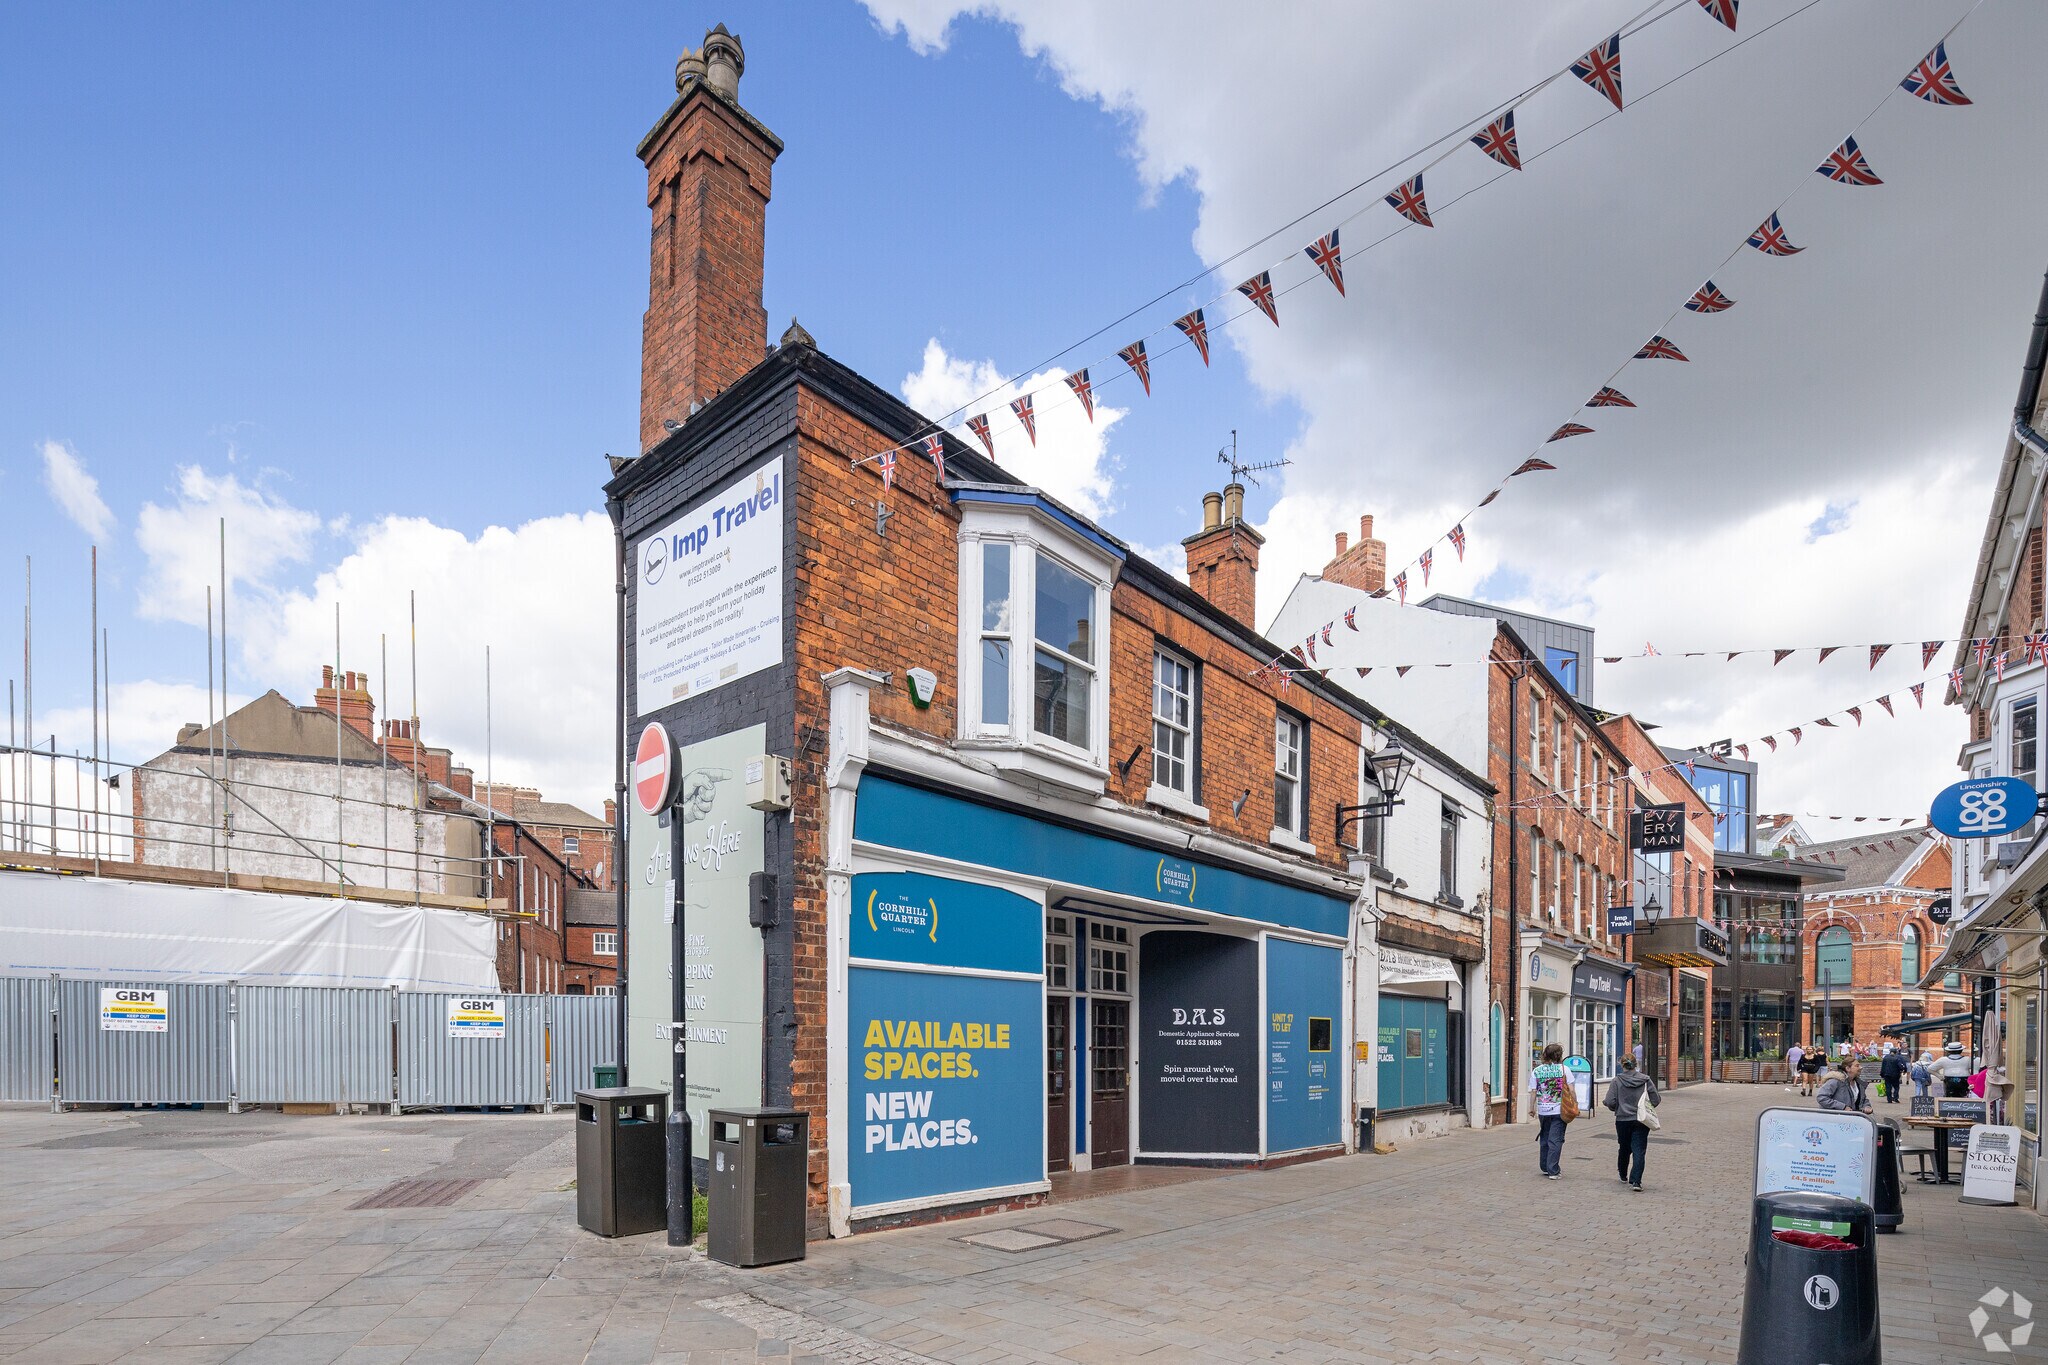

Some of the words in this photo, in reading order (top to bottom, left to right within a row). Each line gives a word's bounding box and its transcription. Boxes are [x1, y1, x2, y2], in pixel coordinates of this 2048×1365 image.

[672, 525, 708, 561] Imp
[712, 474, 778, 536] Travel
[679, 546, 730, 578] www.imptravel.co.uk
[687, 573, 702, 586] 01522
[640, 629, 644, 637] A
[645, 623, 656, 634] local
[658, 609, 688, 628] independent
[689, 600, 703, 613] travel
[705, 593, 719, 606] agent
[721, 586, 732, 597] with
[734, 582, 742, 591] the
[744, 565, 777, 586] experience
[649, 634, 658, 644] and
[659, 623, 685, 639] knowledge
[693, 614, 704, 624] help
[706, 609, 715, 620] you
[717, 602, 727, 613] turn
[729, 595, 742, 608] your
[743, 584, 765, 599] holiday
[667, 638, 676, 648] and
[677, 631, 691, 644] travel
[693, 623, 711, 636] dreams
[713, 618, 723, 627] into
[724, 606, 743, 622] reality!
[657, 661, 673, 672] including
[684, 652, 692, 661] Cost
[693, 646, 708, 656] Airlines
[711, 640, 722, 648] Tailor
[760, 615, 779, 627] Cruising
[663, 667, 680, 679] Protected
[682, 660, 699, 671] Packages
[703, 655, 709, 663] UK
[710, 648, 727, 660] Holidays
[732, 640, 746, 650] Coach
[748, 634, 760, 643] Tours
[1960, 781, 2007, 791] Lincolnshire
[1644, 811, 1664, 821] EV
[1644, 822, 1676, 834] ERY
[701, 820, 741, 872] HERE
[1644, 835, 1680, 847] MAN
[1163, 869, 1190, 881] CORNHILL
[1163, 877, 1189, 889] QUARTER
[878, 902, 928, 917] CORNHILL
[881, 912, 926, 926] QUARTER
[893, 926, 915, 934] LINCOLN
[689, 934, 705, 946] FINE
[668, 963, 713, 979] SPPING
[1589, 974, 1598, 992] Imp
[116, 990, 154, 1002] GBM
[461, 1000, 494, 1010] GBM
[1172, 1008, 1226, 1025] D.A.S
[1272, 1013, 1286, 1022] UNIT
[1287, 1014, 1294, 1023] 17
[864, 1020, 1010, 1049] AVAILABLE
[1272, 1023, 1280, 1032] TO
[1282, 1023, 1291, 1032] LET
[864, 1052, 978, 1080] SPACES.
[1164, 1065, 1182, 1073] Spin
[866, 1091, 933, 1120] NEW
[866, 1118, 978, 1153] PLACES.
[1968, 1152, 2016, 1164] STOKES
[1990, 1164, 2012, 1173] coffee
